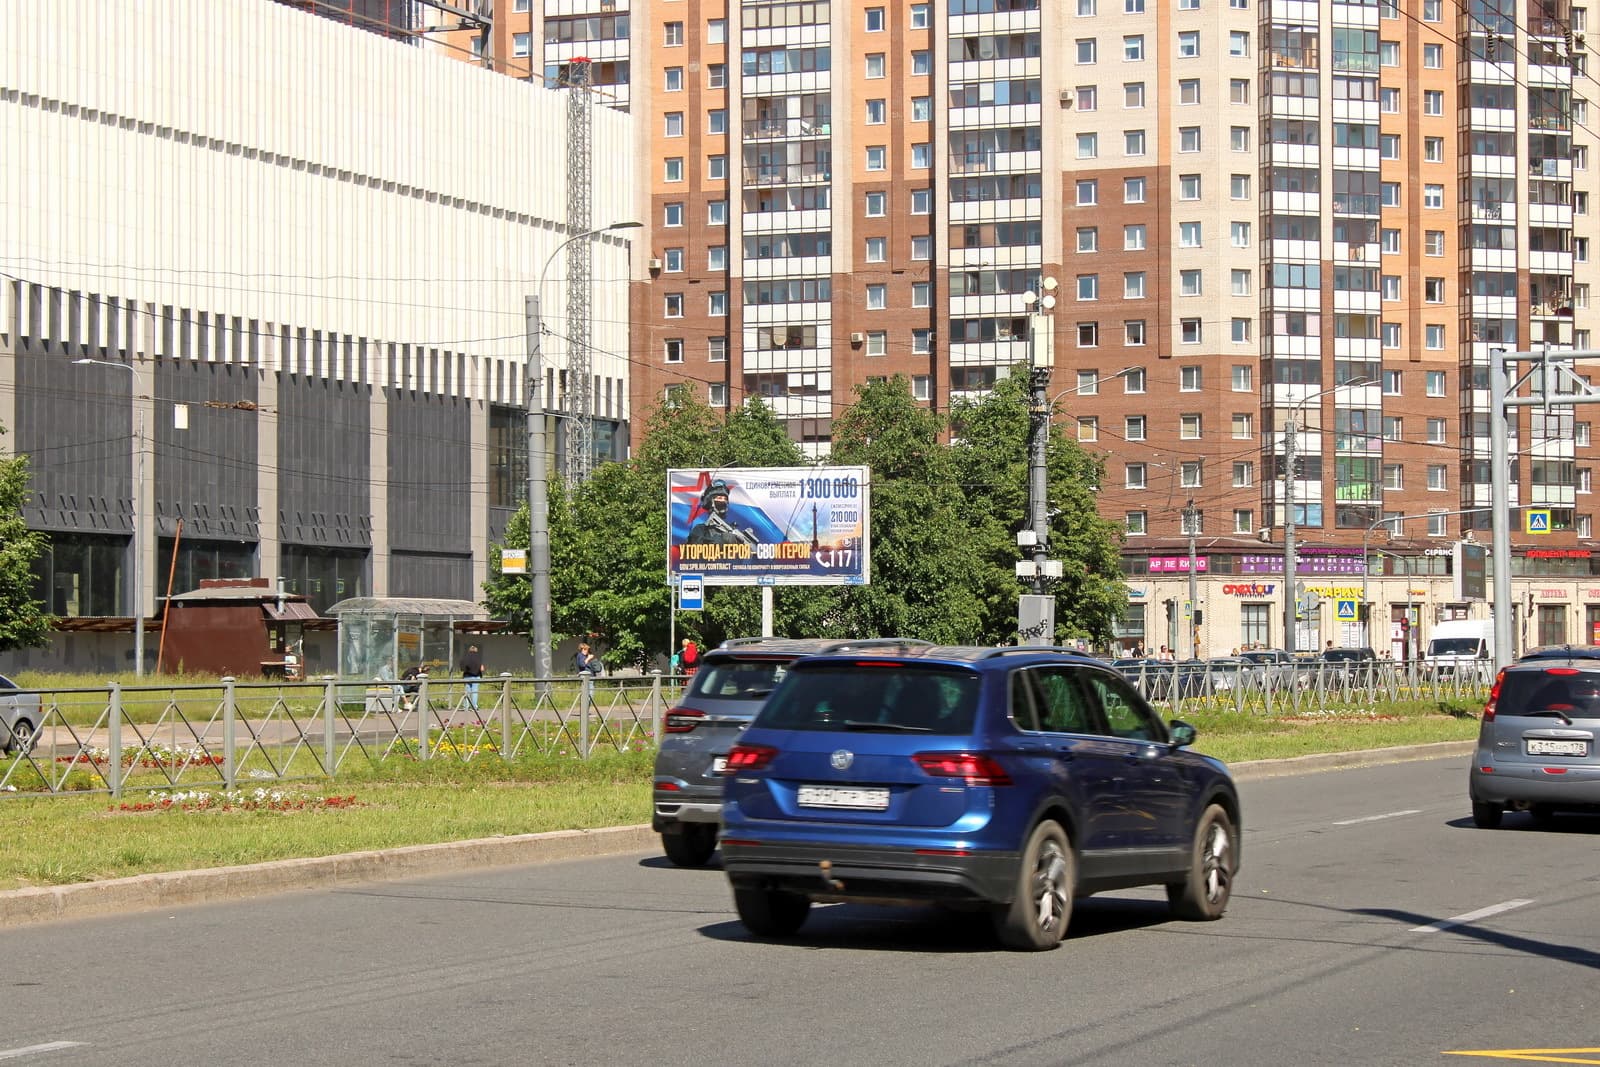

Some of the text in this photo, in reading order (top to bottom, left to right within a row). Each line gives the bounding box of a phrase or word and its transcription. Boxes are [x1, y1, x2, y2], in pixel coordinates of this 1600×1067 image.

[831, 511, 857, 523] 210 000
[679, 544, 685, 560] У
[686, 544, 751, 561] ГОРОДА-ГЕРОЯ
[757, 544, 781, 559] СВОИ
[782, 544, 810, 559] ГЕРОИ
[829, 550, 852, 568] 117
